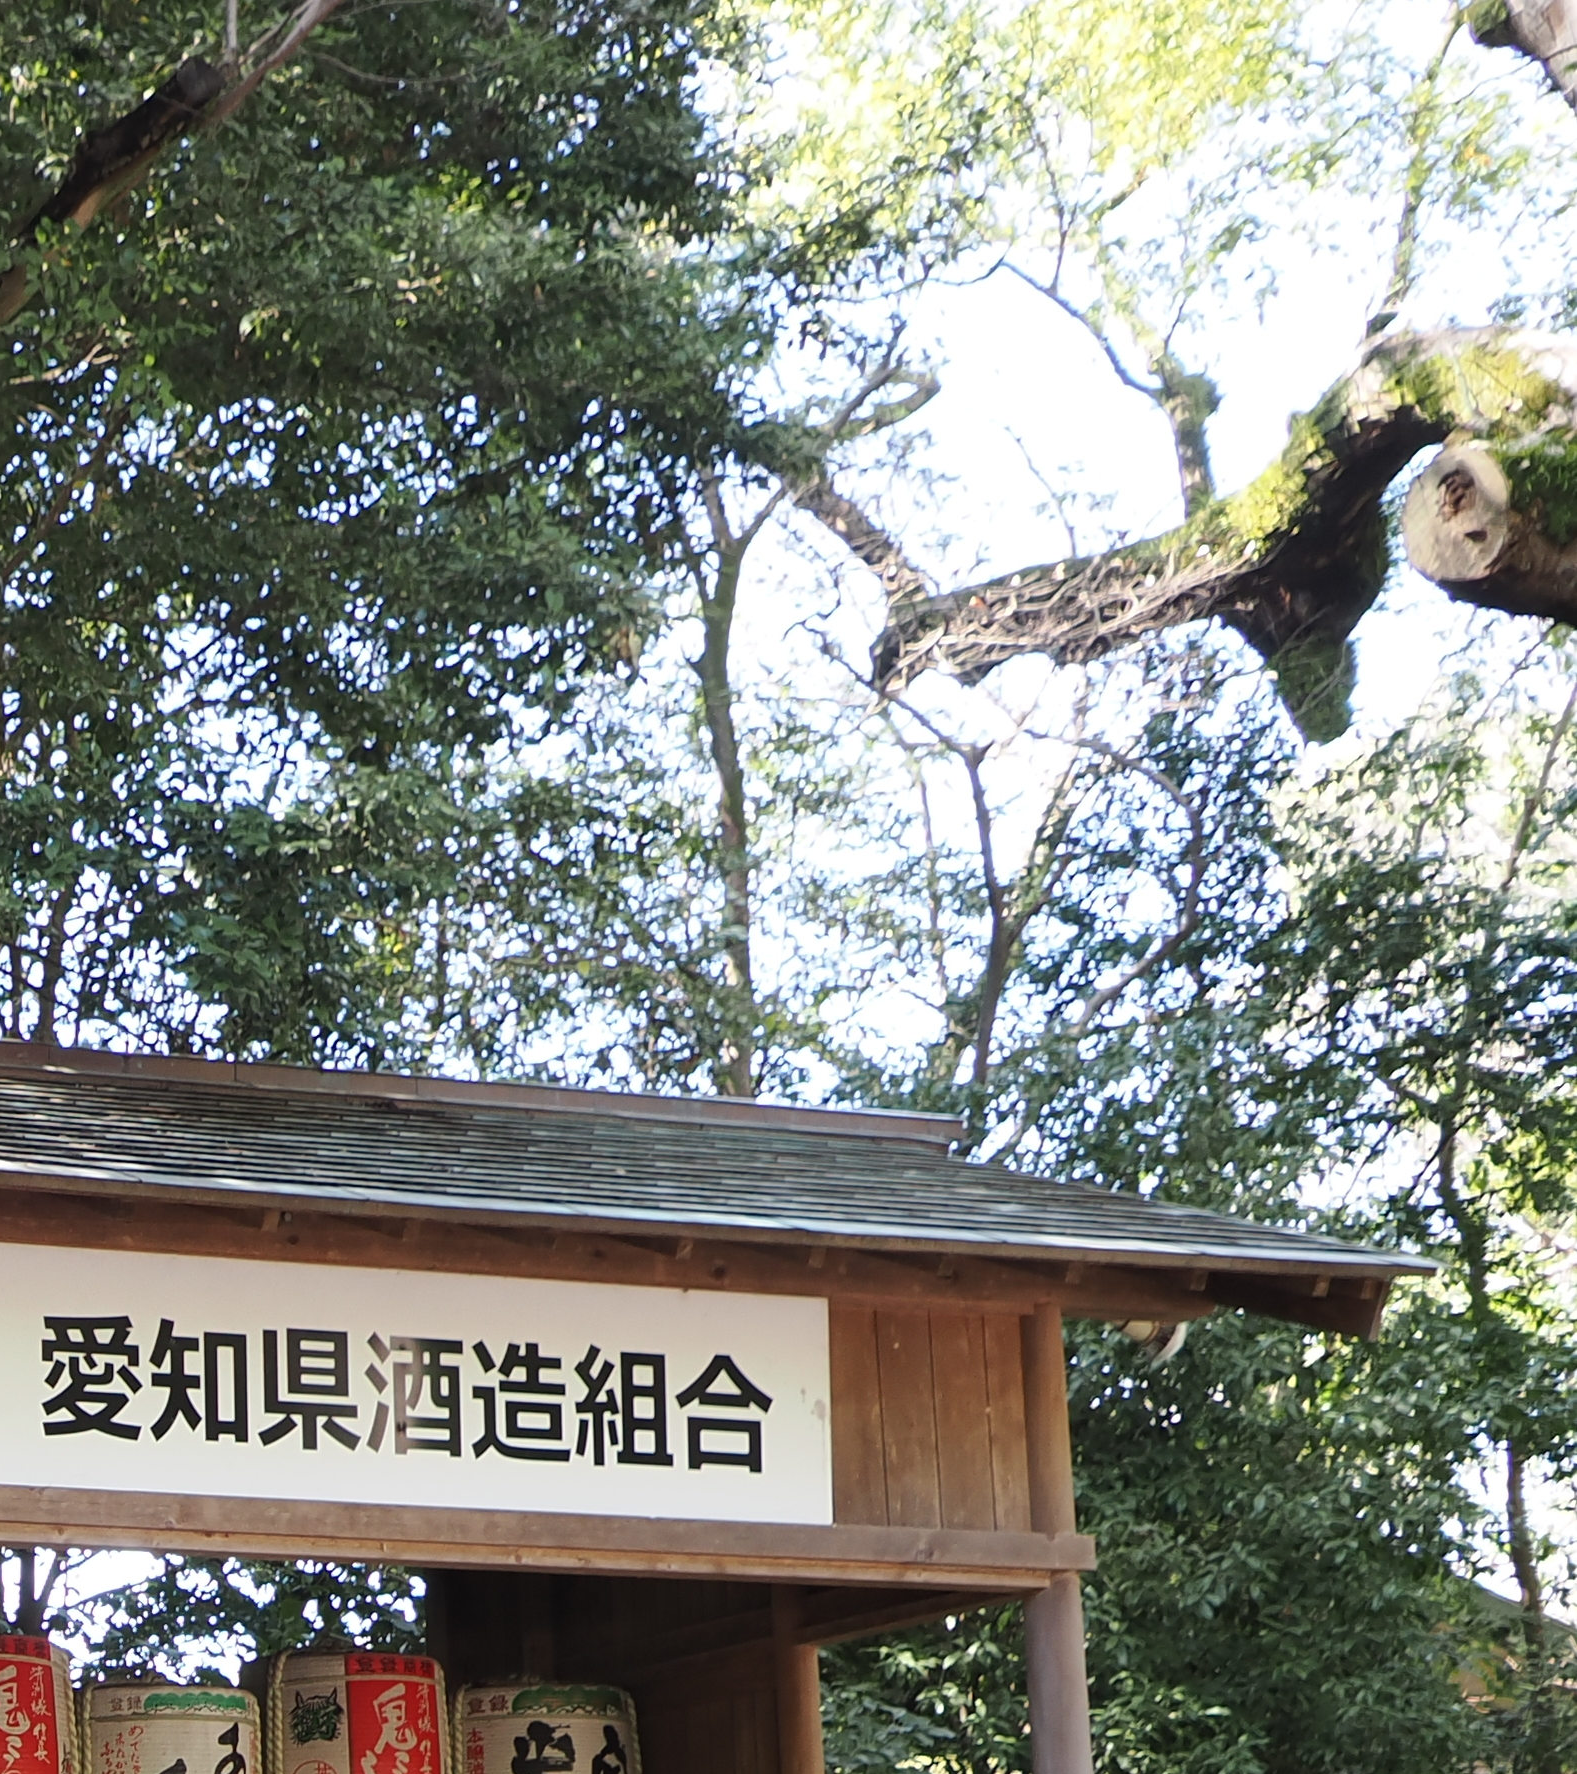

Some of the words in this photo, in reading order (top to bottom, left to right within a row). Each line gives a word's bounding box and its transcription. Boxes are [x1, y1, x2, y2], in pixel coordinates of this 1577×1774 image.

[40, 1314, 773, 1474] 愛知県酒造組合
